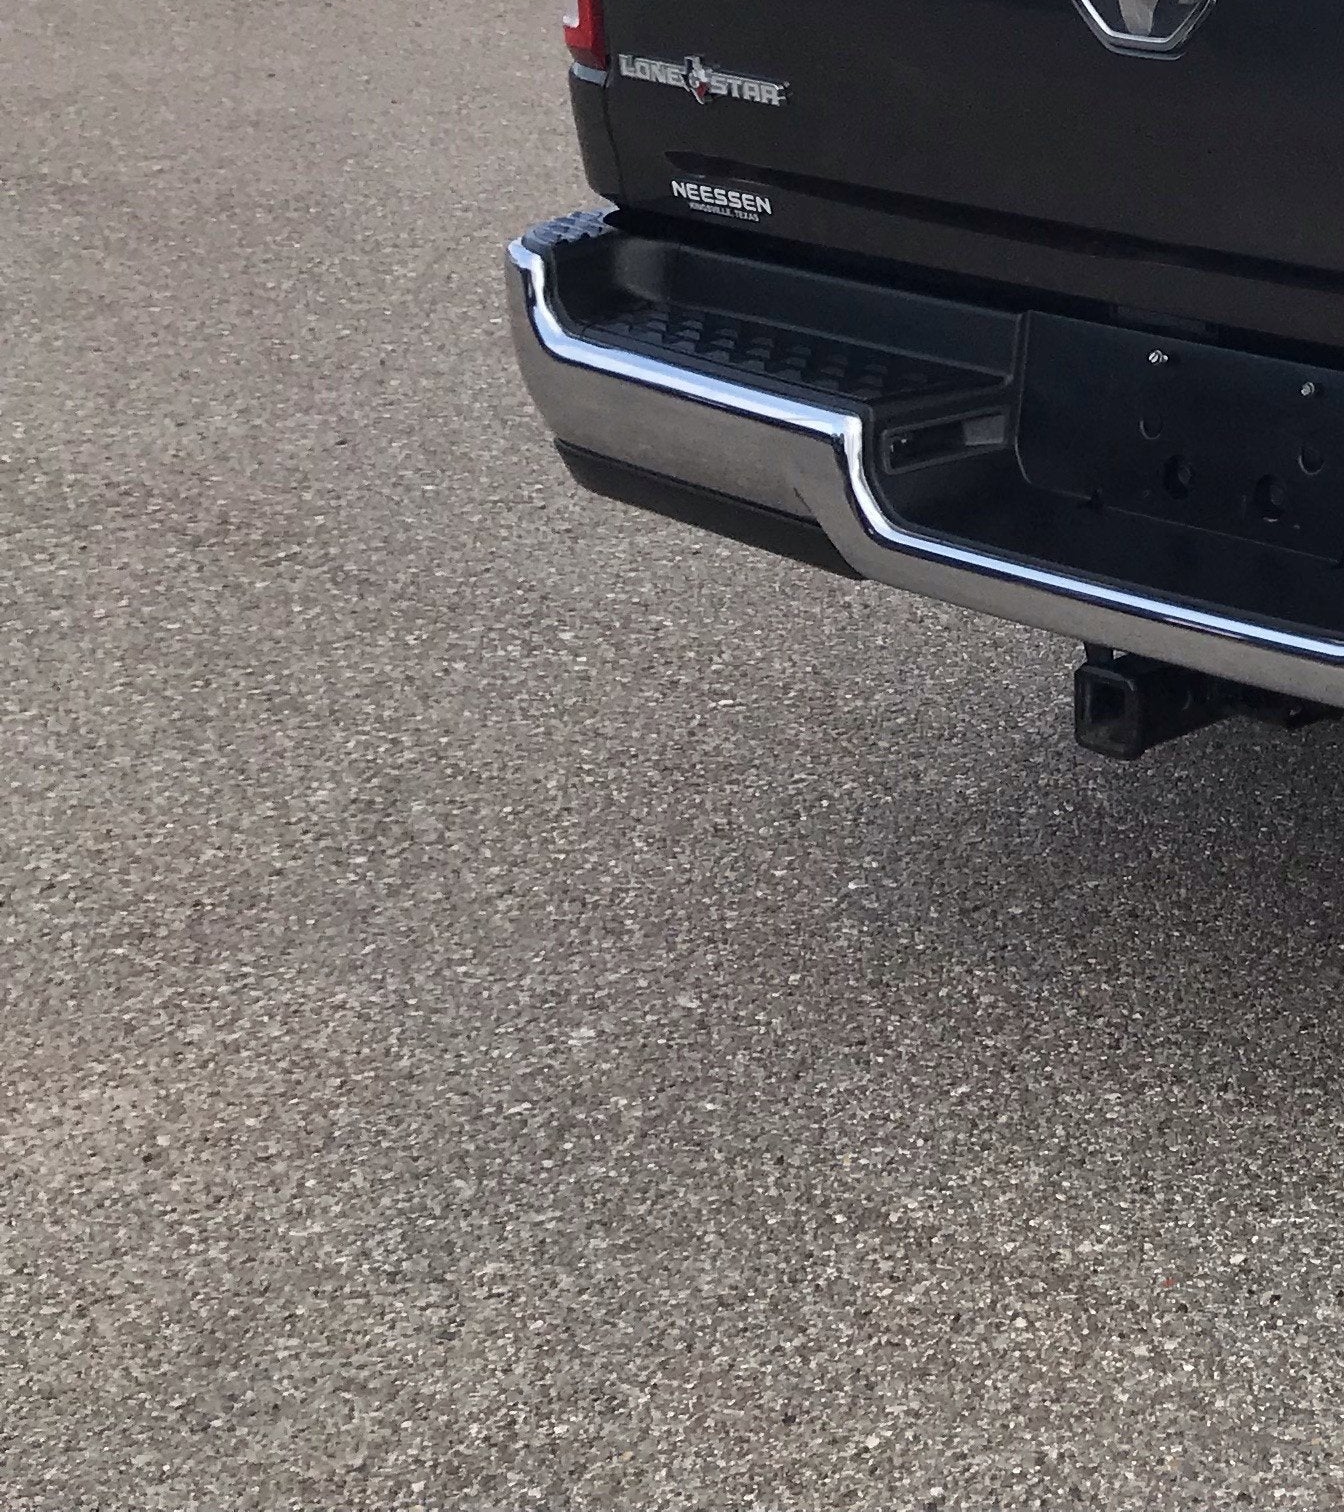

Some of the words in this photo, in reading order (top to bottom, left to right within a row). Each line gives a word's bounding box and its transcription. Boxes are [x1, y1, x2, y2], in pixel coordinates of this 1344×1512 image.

[618, 53, 685, 88] LONE
[709, 71, 782, 106] STAR
[671, 180, 772, 215] NEESSEN
